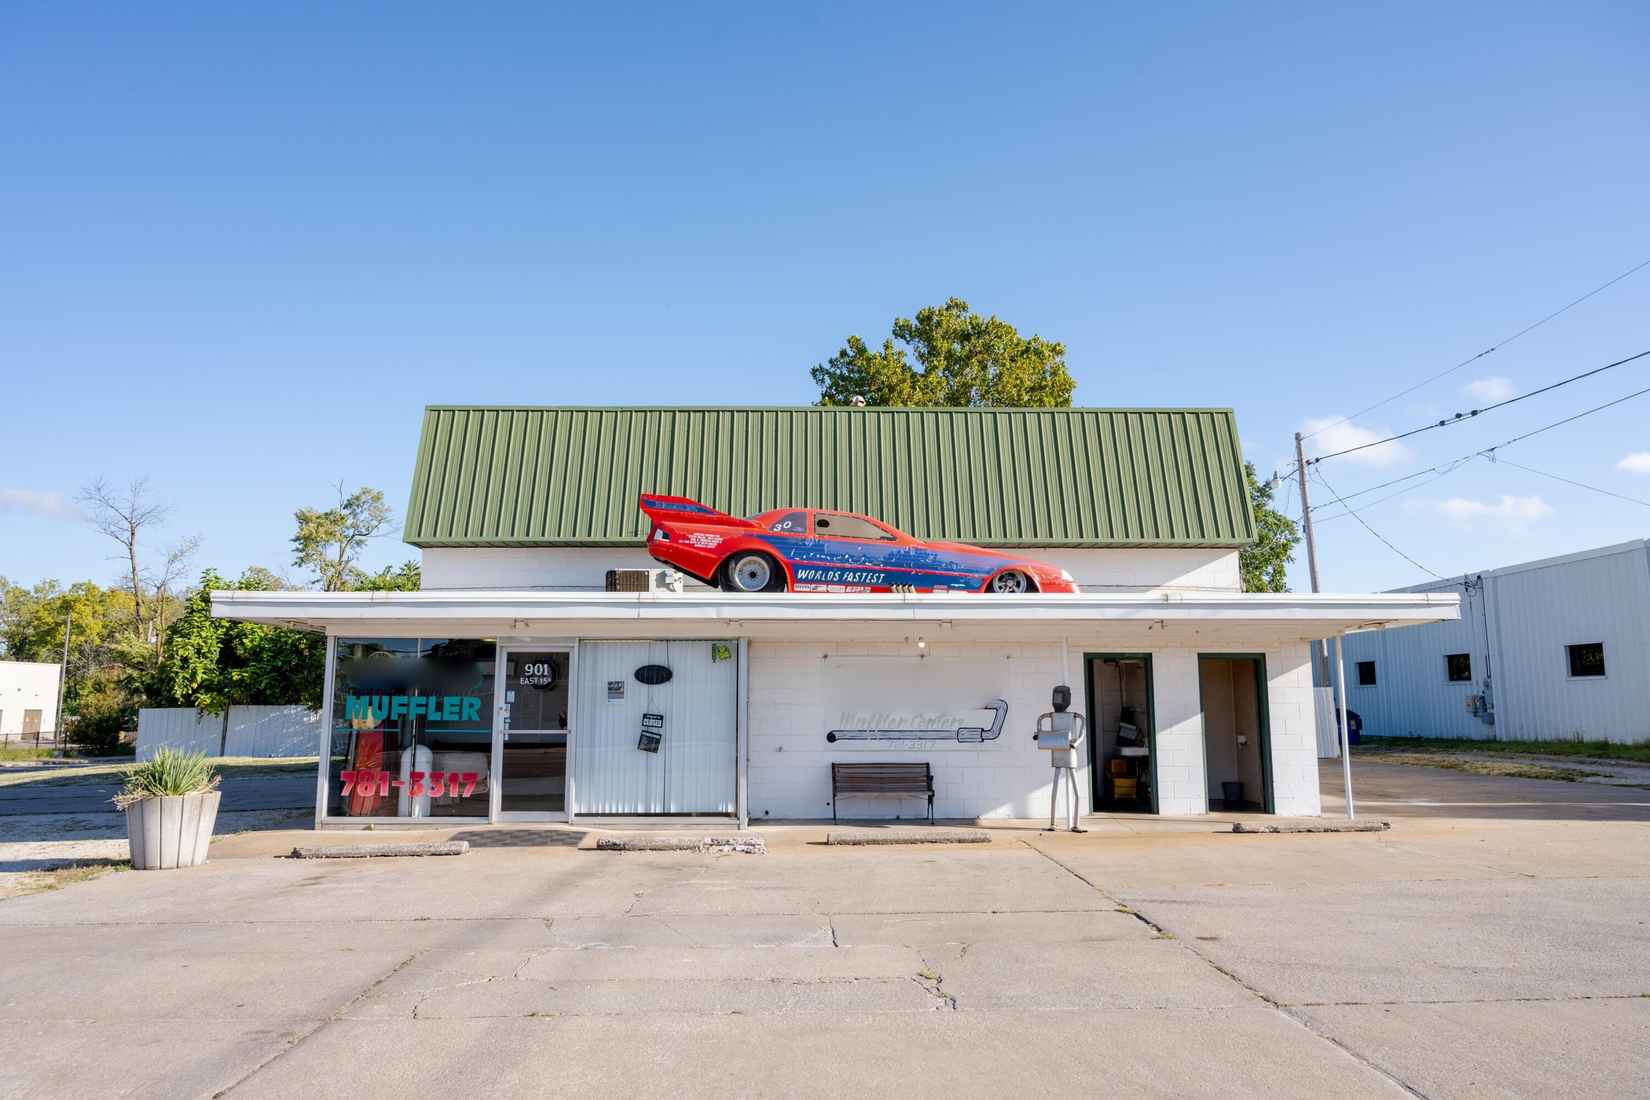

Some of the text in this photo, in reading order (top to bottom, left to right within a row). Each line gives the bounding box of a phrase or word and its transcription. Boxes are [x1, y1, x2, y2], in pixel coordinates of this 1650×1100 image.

[797, 569, 885, 583] WORLDS FASTEST
[524, 663, 549, 676] 901
[520, 677, 538, 685] EAST
[345, 695, 481, 721] MUFFLER
[340, 770, 478, 798] 781-3317
